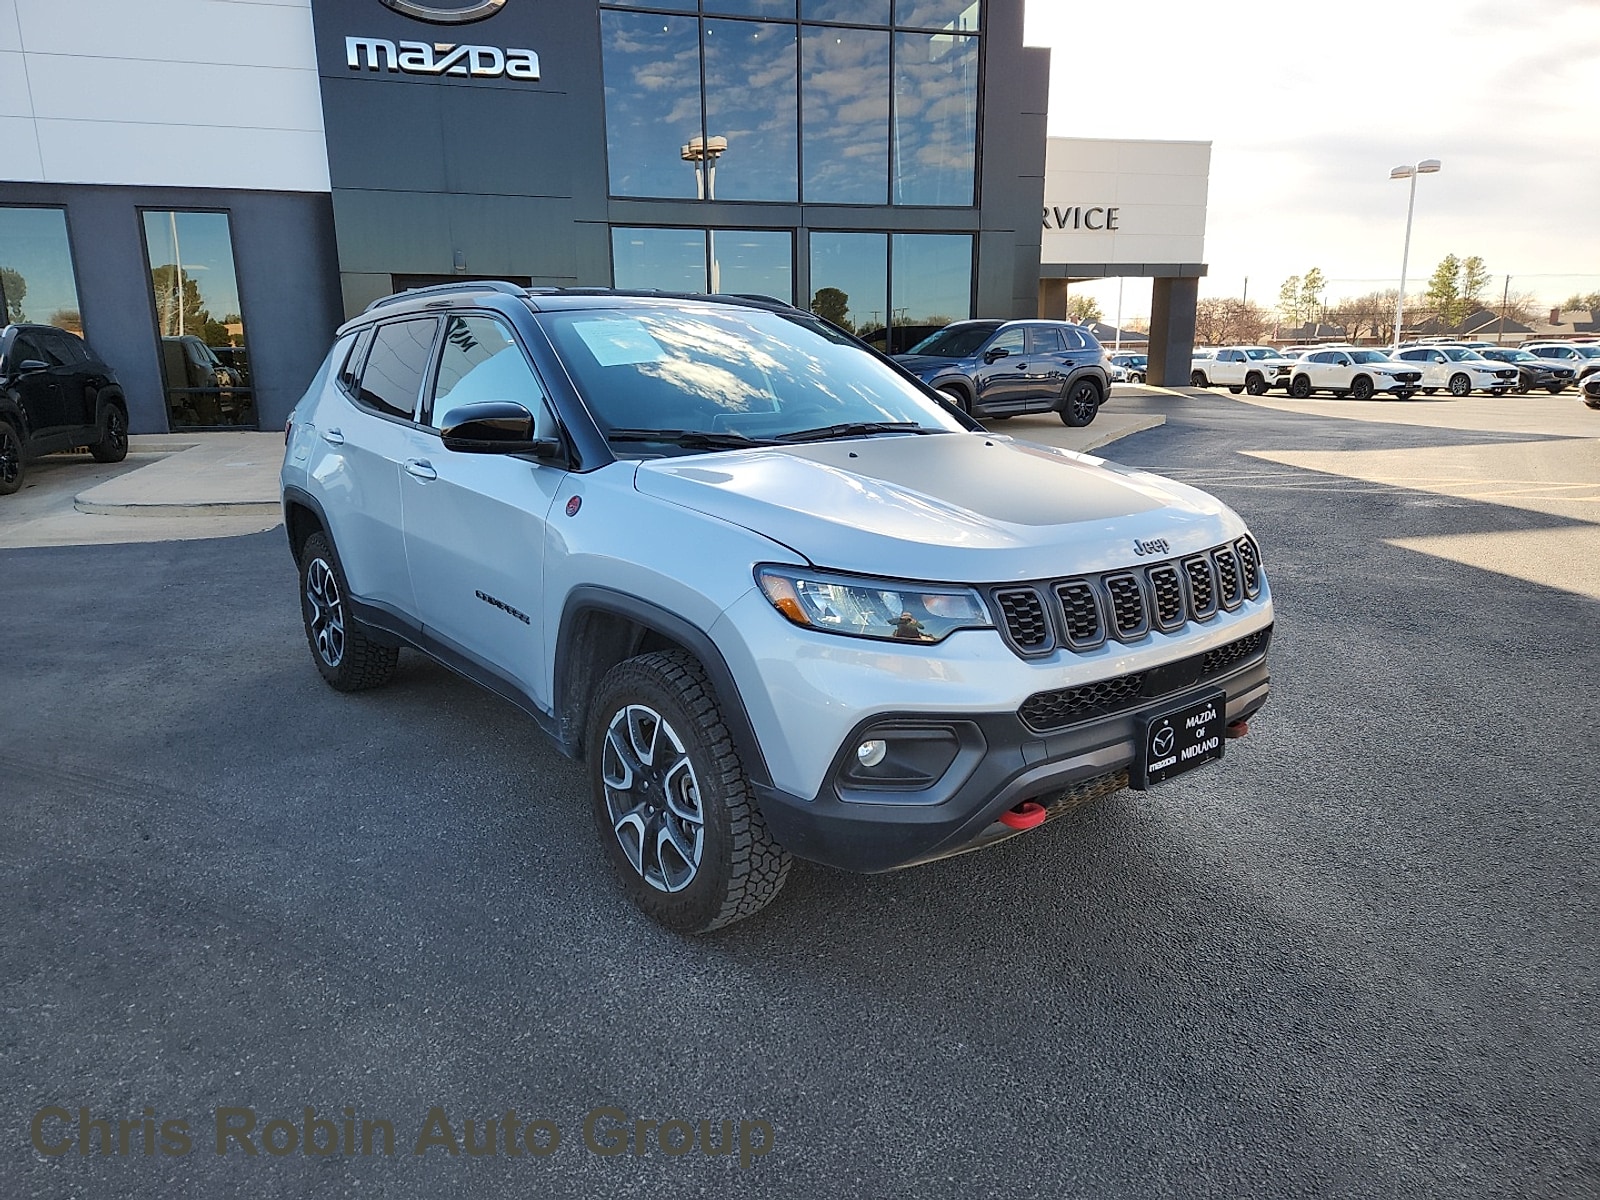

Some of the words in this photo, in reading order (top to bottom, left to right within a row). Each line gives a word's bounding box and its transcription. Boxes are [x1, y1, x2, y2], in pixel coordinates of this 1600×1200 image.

[1133, 538, 1170, 557] Jeep
[1185, 709, 1217, 729] MAZDA
[1180, 736, 1219, 761] MIDLAND
